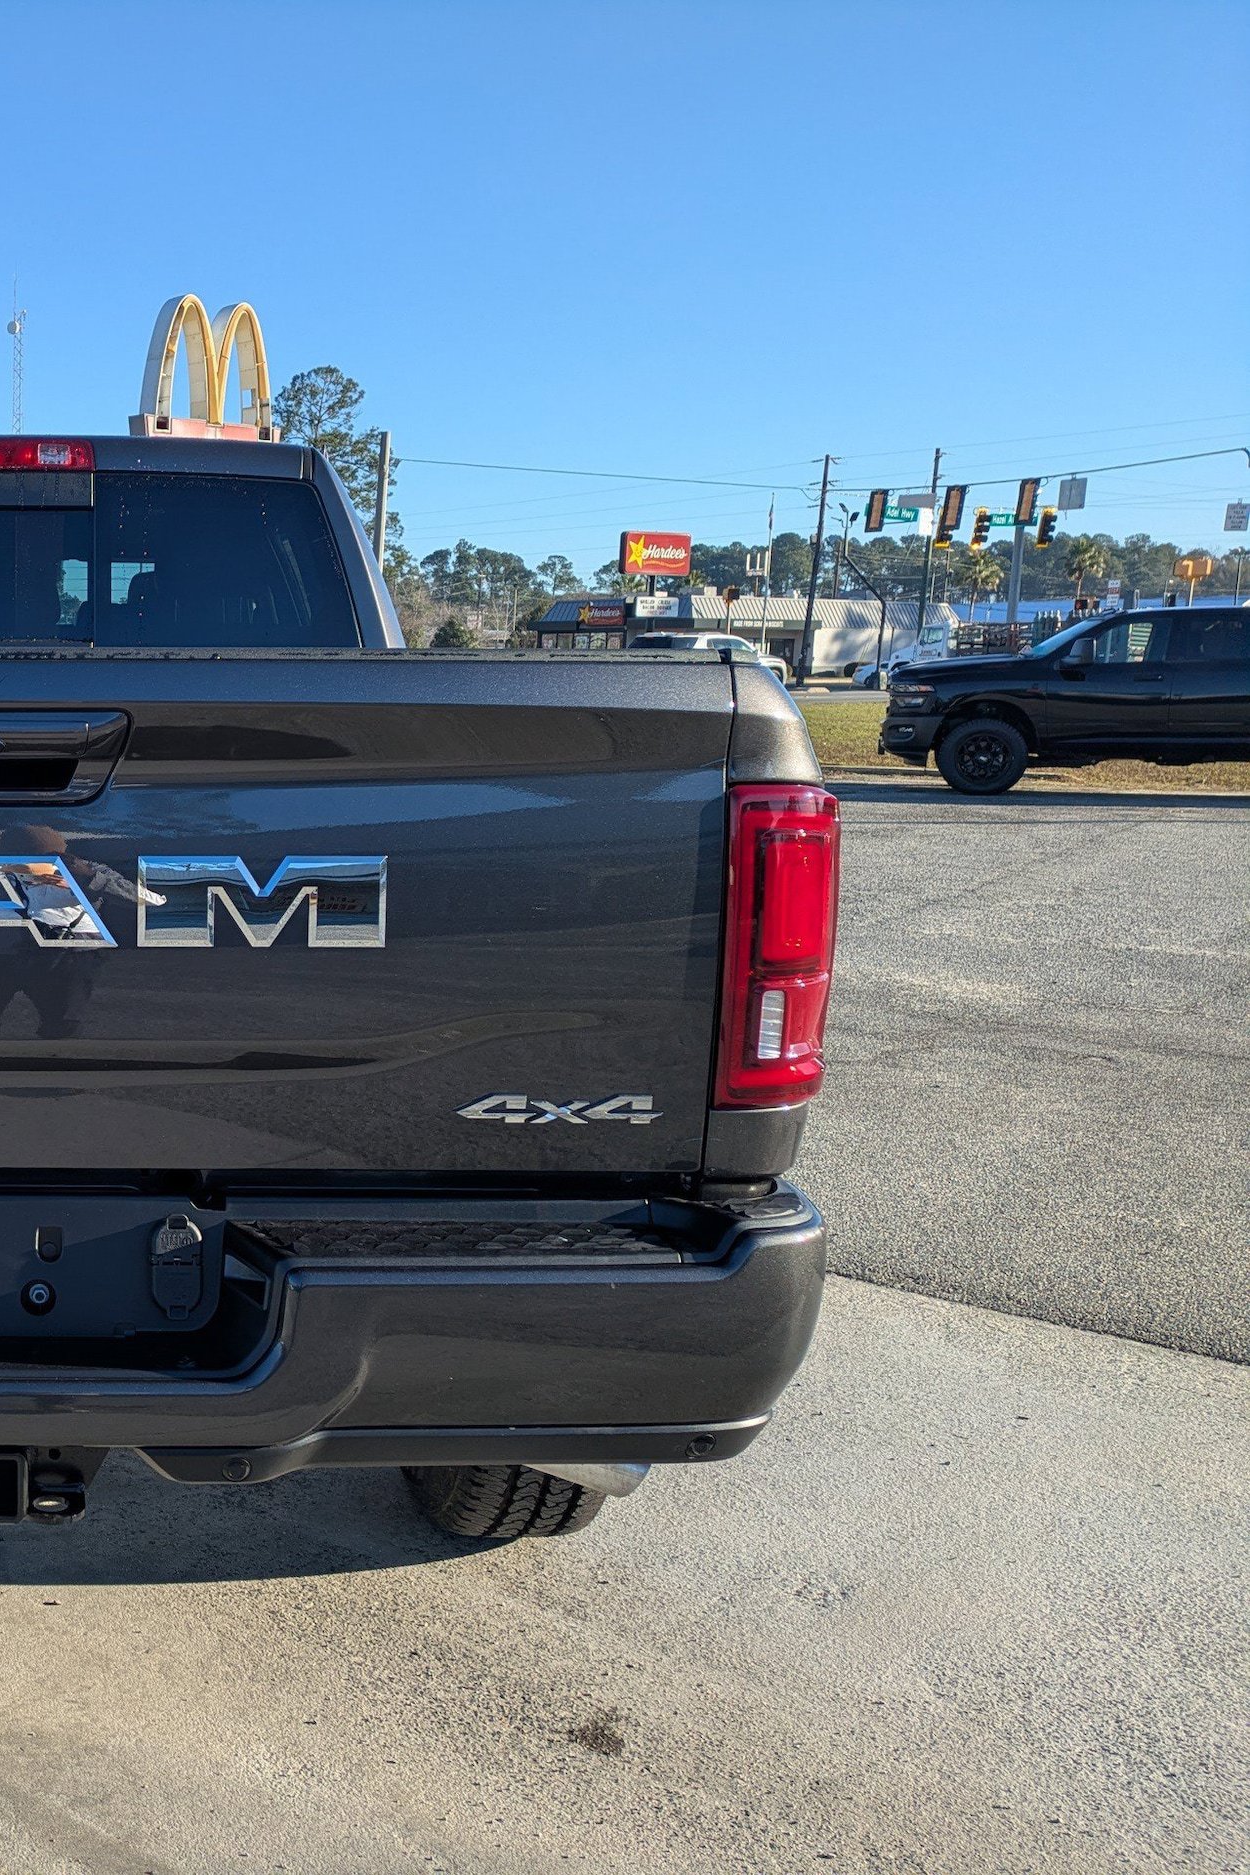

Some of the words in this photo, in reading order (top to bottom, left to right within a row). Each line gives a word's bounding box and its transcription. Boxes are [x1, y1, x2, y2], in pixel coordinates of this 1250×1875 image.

[901, 507, 916, 521] Hwy
[992, 514, 1006, 525] Hazel
[642, 544, 688, 560] Hardee's
[588, 607, 621, 618] Hardee's
[453, 1093, 664, 1124] 4x4
